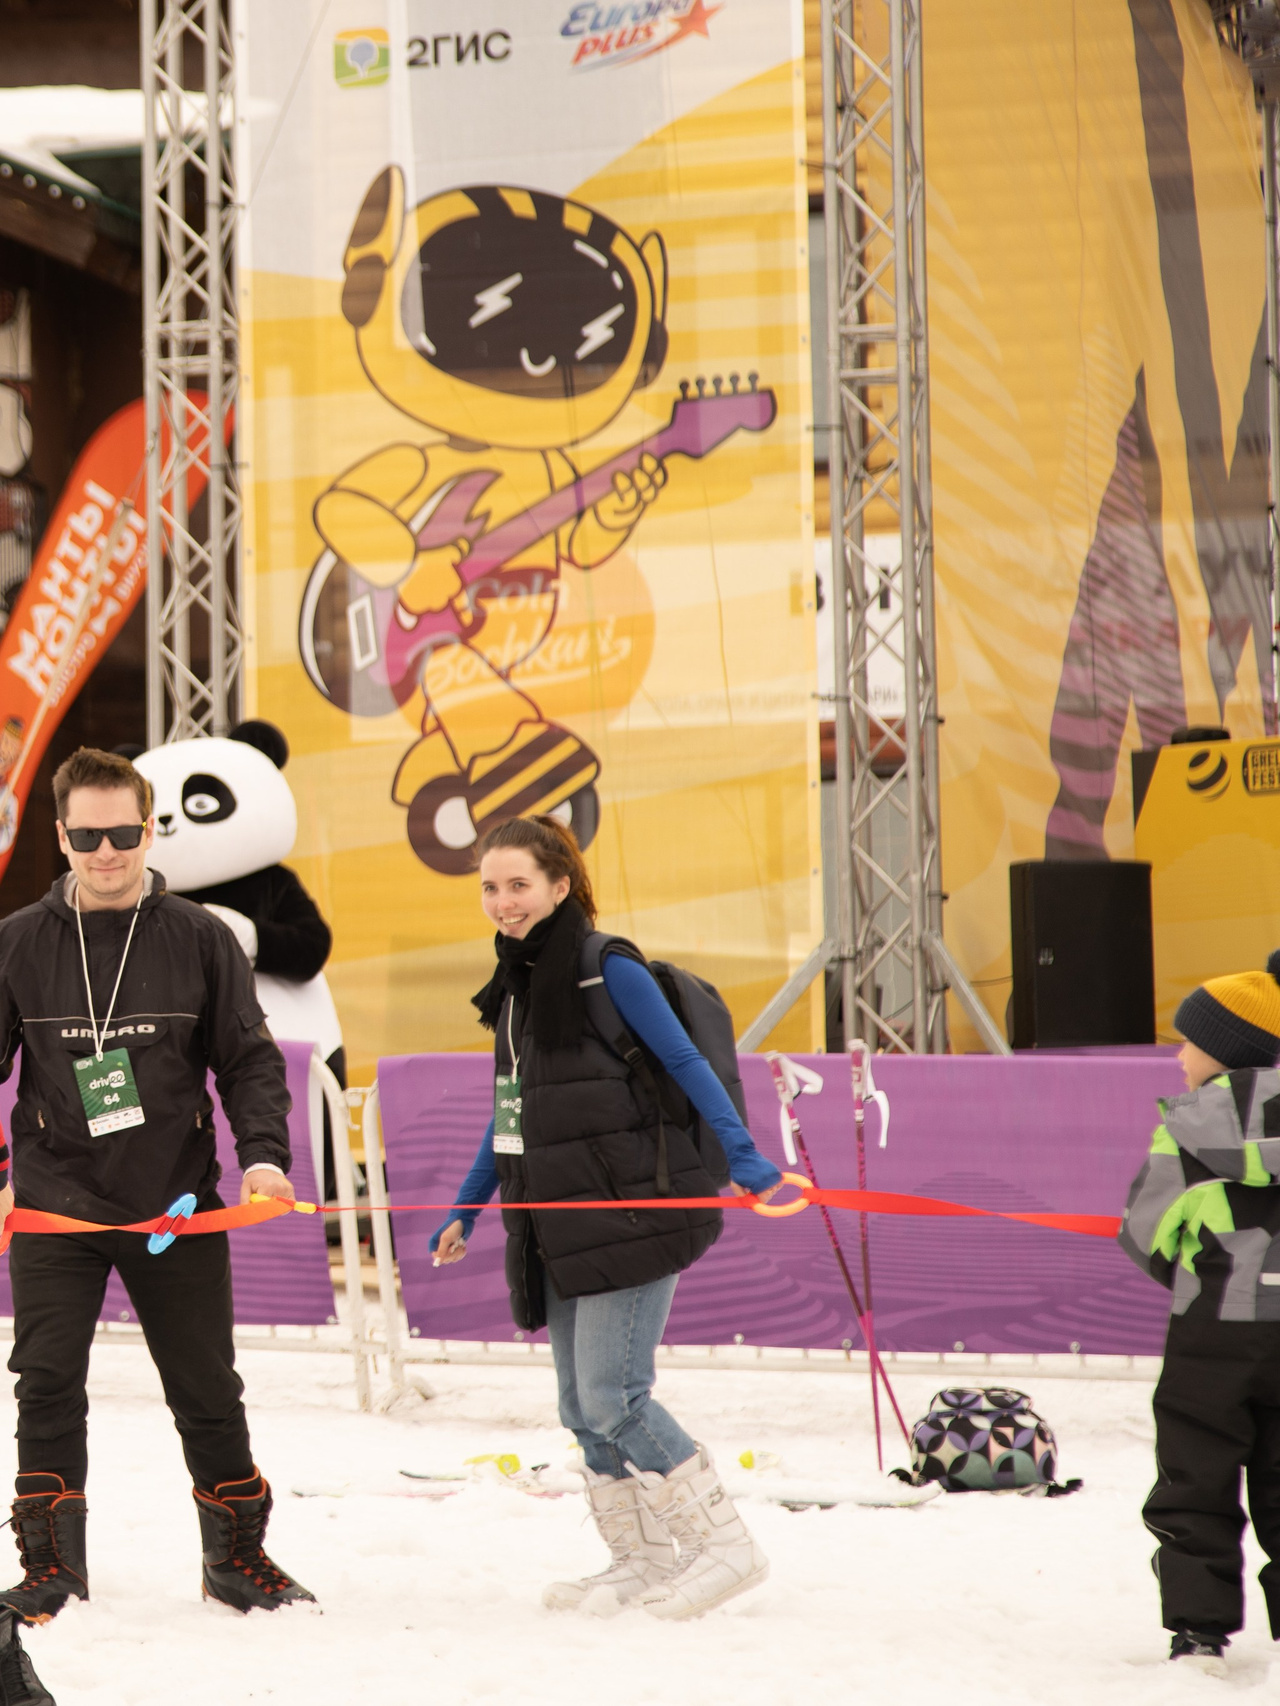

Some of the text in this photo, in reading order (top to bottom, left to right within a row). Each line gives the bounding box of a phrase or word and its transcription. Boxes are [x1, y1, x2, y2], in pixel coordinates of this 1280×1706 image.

[407, 31, 512, 68] 2ГИС
[5, 478, 115, 680] МАНТЫ
[104, 1092, 121, 1105] 64
